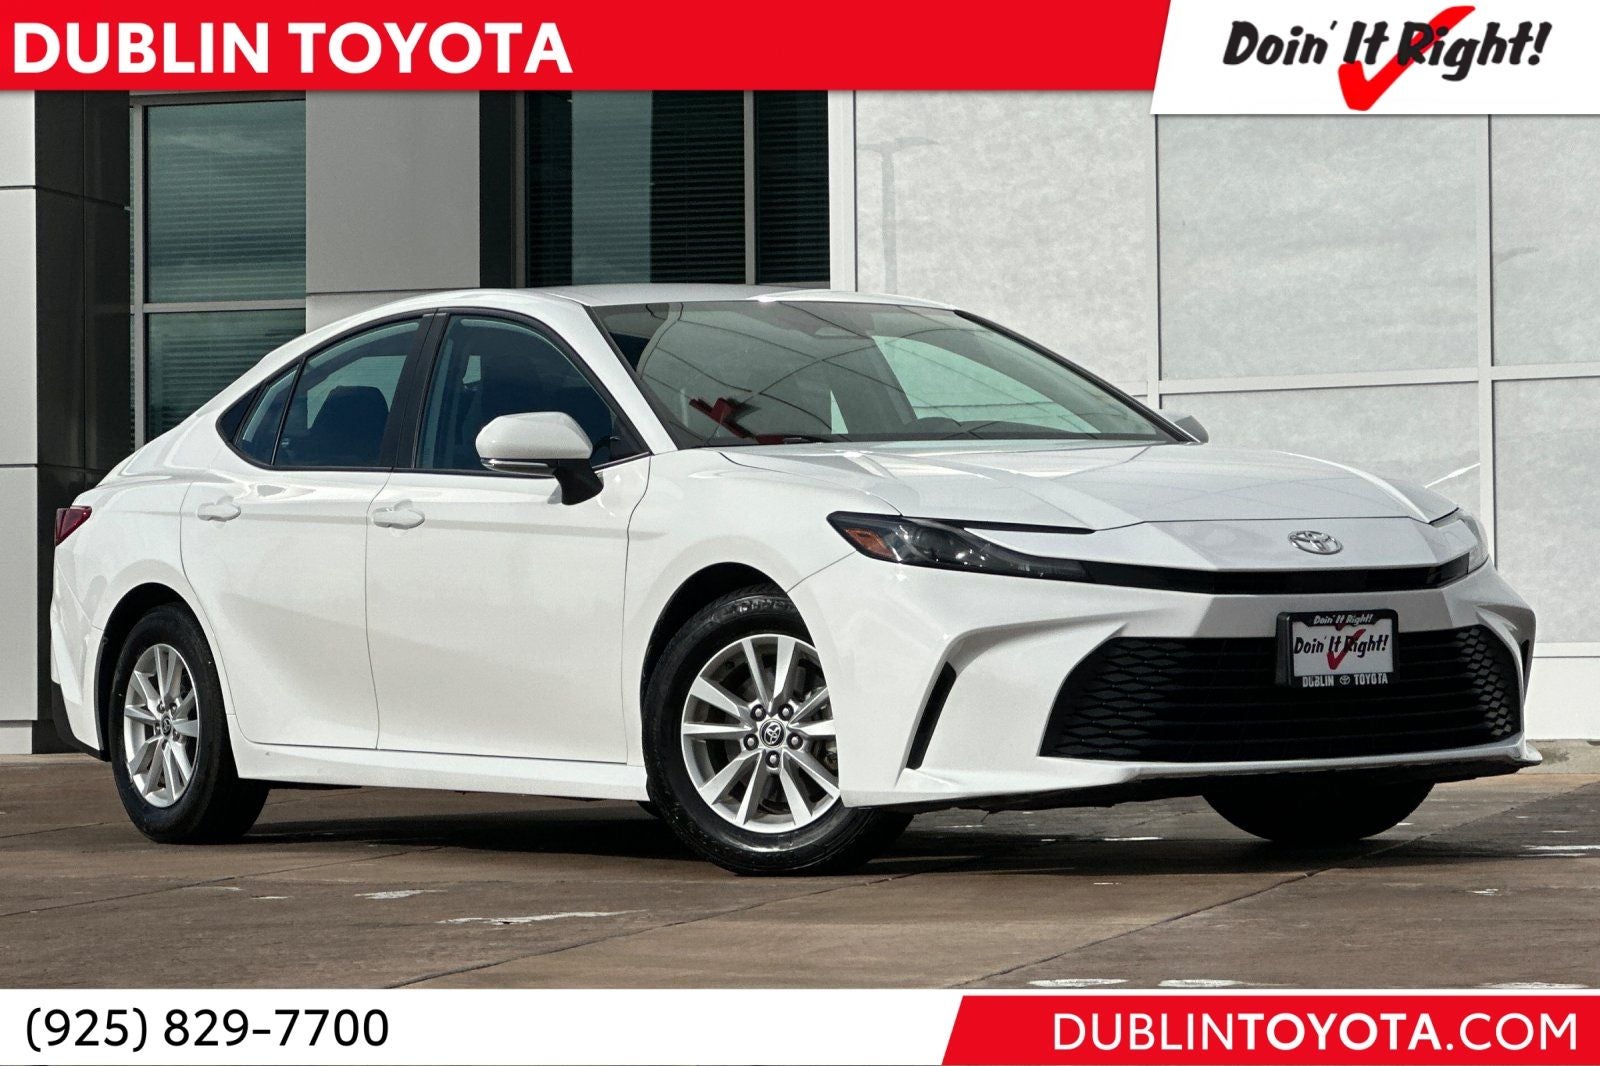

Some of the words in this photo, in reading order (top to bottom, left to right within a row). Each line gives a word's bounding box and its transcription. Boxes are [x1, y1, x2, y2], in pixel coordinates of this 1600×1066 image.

[1294, 636, 1327, 654] Doin'
[1328, 636, 1342, 653] It
[1344, 634, 1389, 658] Right!
[1302, 676, 1335, 688] DUBLIN
[1353, 672, 1389, 685] TOYOTA
